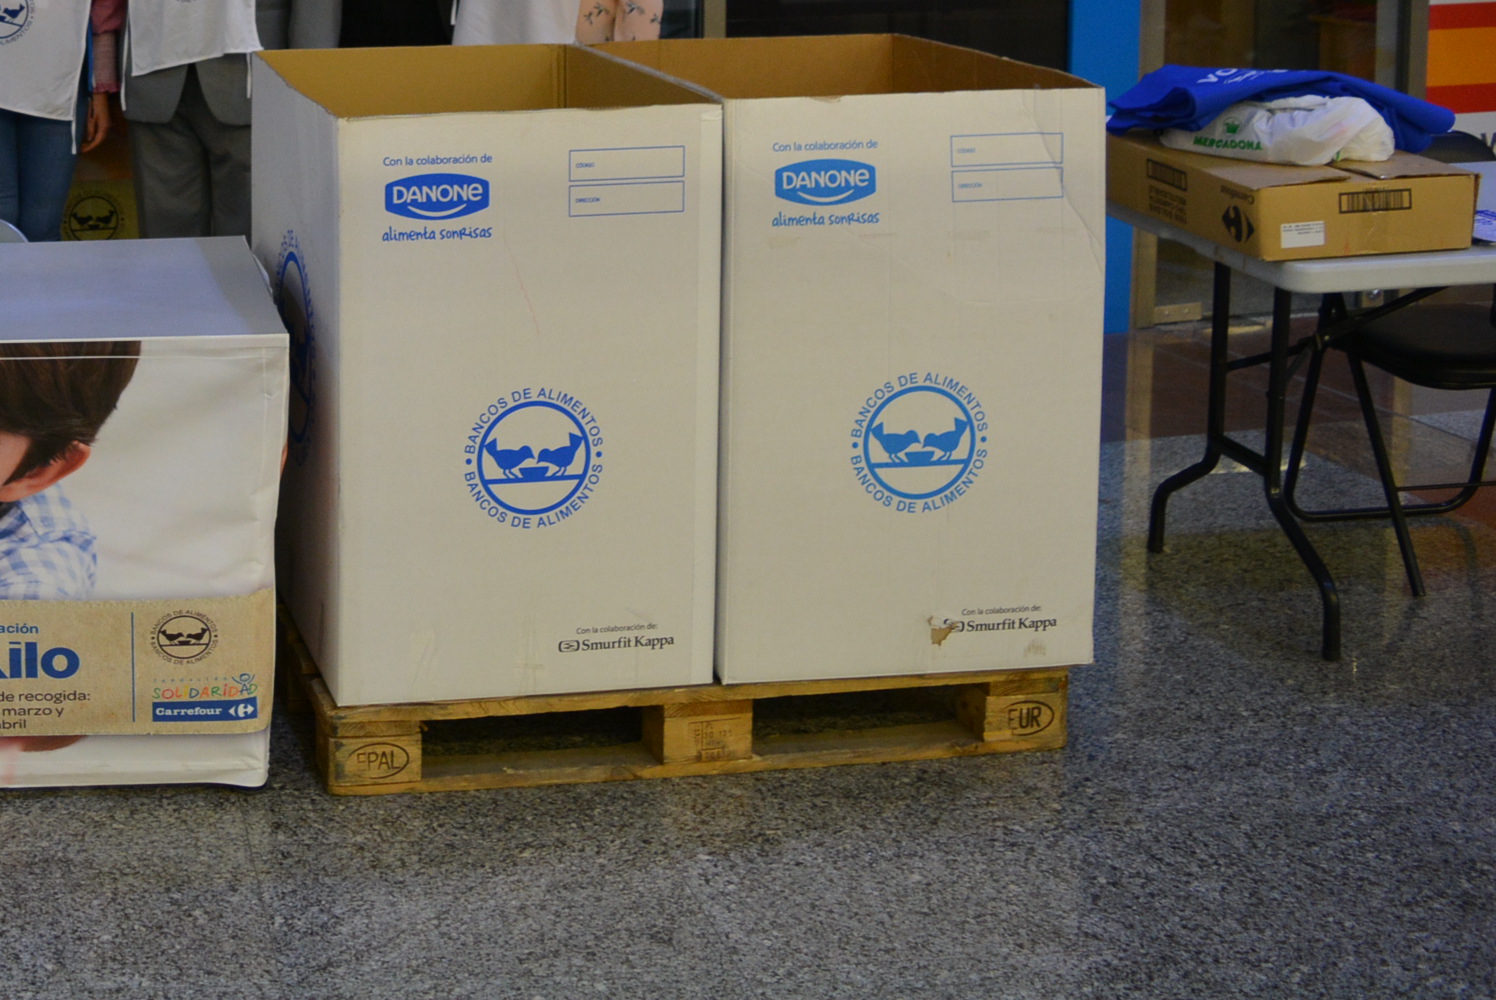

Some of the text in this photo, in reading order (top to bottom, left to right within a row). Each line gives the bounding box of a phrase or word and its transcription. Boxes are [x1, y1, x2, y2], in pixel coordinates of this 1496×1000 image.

[772, 138, 878, 154] Con la colaboración de
[1193, 135, 1262, 151] MERCADONA
[382, 153, 493, 170] Con la colaboración de
[771, 211, 825, 227] alimenta
[382, 226, 436, 242] alimenta
[851, 372, 989, 438] BANCOS DE ALIMENTOS
[464, 387, 604, 455] BANCOS DE ALIMENTOS
[850, 448, 988, 513] BANCOS DE ALIMENTOS
[464, 463, 603, 529] BANCOS DE ALIMENTOS
[965, 617, 1057, 632] Smurfit Kappa
[581, 634, 674, 651] Smurfit Kappa
[16, 689, 91, 706] recogida:
[2, 706, 53, 717] marzo
[54, 707, 64, 720] y
[155, 706, 223, 716] Carrefour
[1007, 706, 1042, 730] EUR
